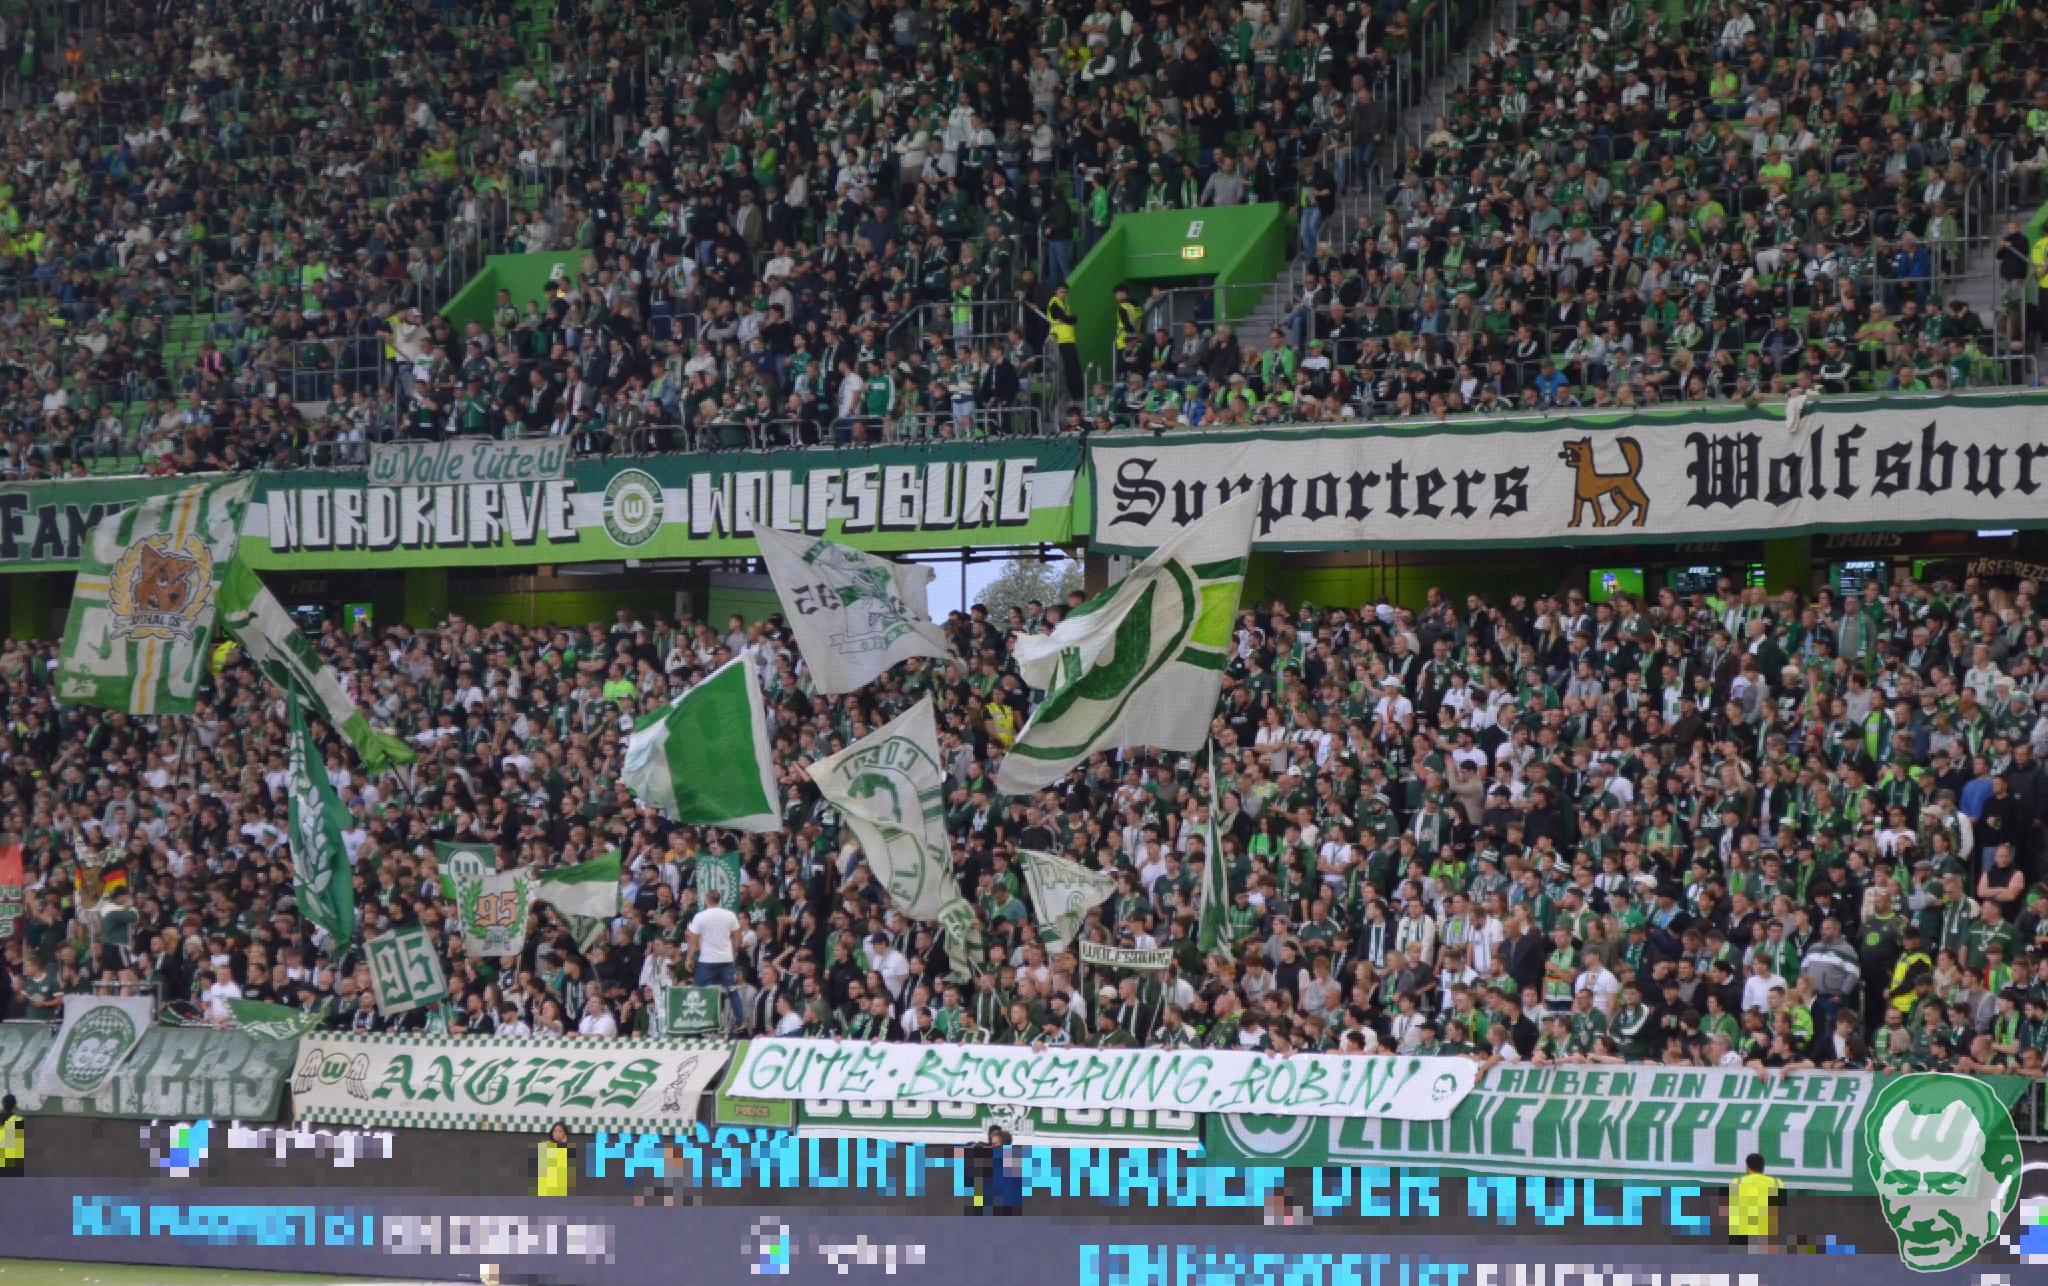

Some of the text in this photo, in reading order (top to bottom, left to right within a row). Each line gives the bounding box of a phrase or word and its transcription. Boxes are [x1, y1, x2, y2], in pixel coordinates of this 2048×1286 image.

[399, 442, 464, 482] Volle
[471, 442, 535, 481] Tüte
[267, 457, 1037, 554] NORDKURVE WOLFSBURG
[474, 891, 519, 927] 95
[375, 936, 438, 1000] 95
[371, 1054, 665, 1110] ANGELS
[1717, 1074, 1861, 1102] UNSER
